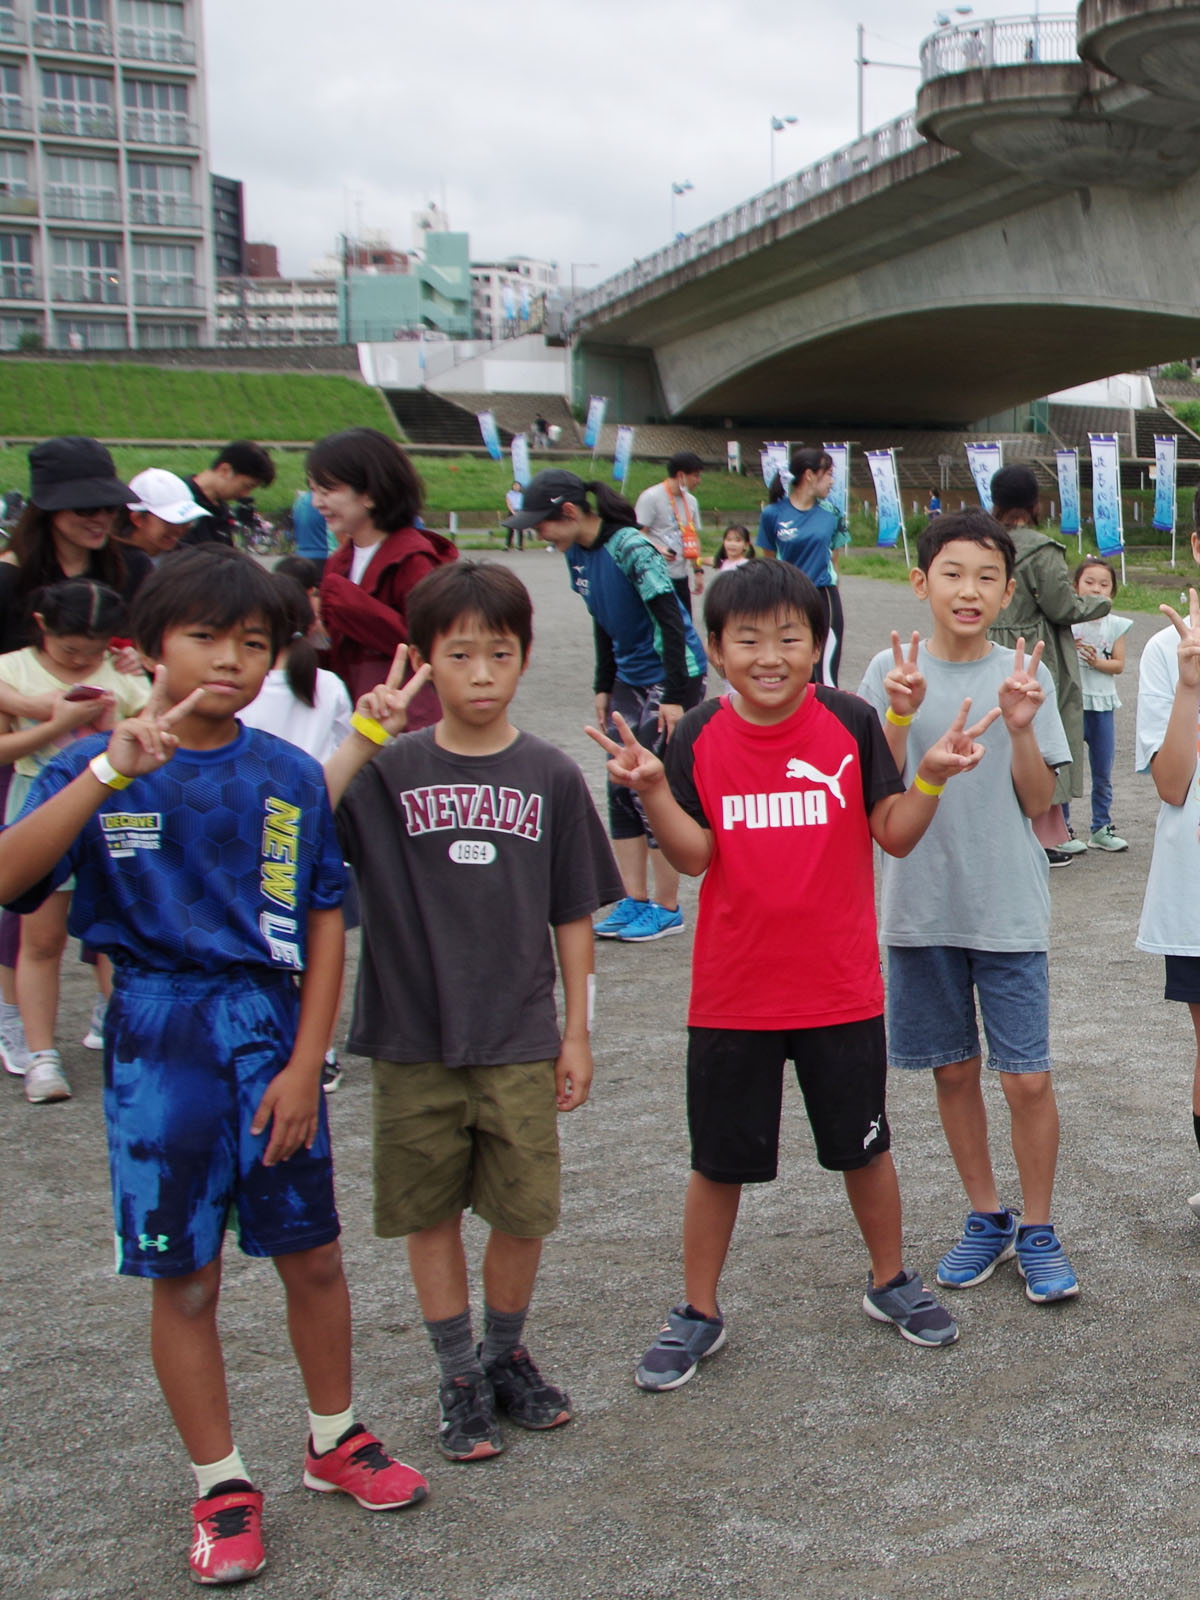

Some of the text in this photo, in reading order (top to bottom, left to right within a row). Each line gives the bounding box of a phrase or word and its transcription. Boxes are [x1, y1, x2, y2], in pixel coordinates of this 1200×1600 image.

[400, 784, 542, 842] NEVADA
[721, 789, 828, 831] PUMA
[261, 796, 302, 911] NEW
[457, 844, 488, 860] 1864
